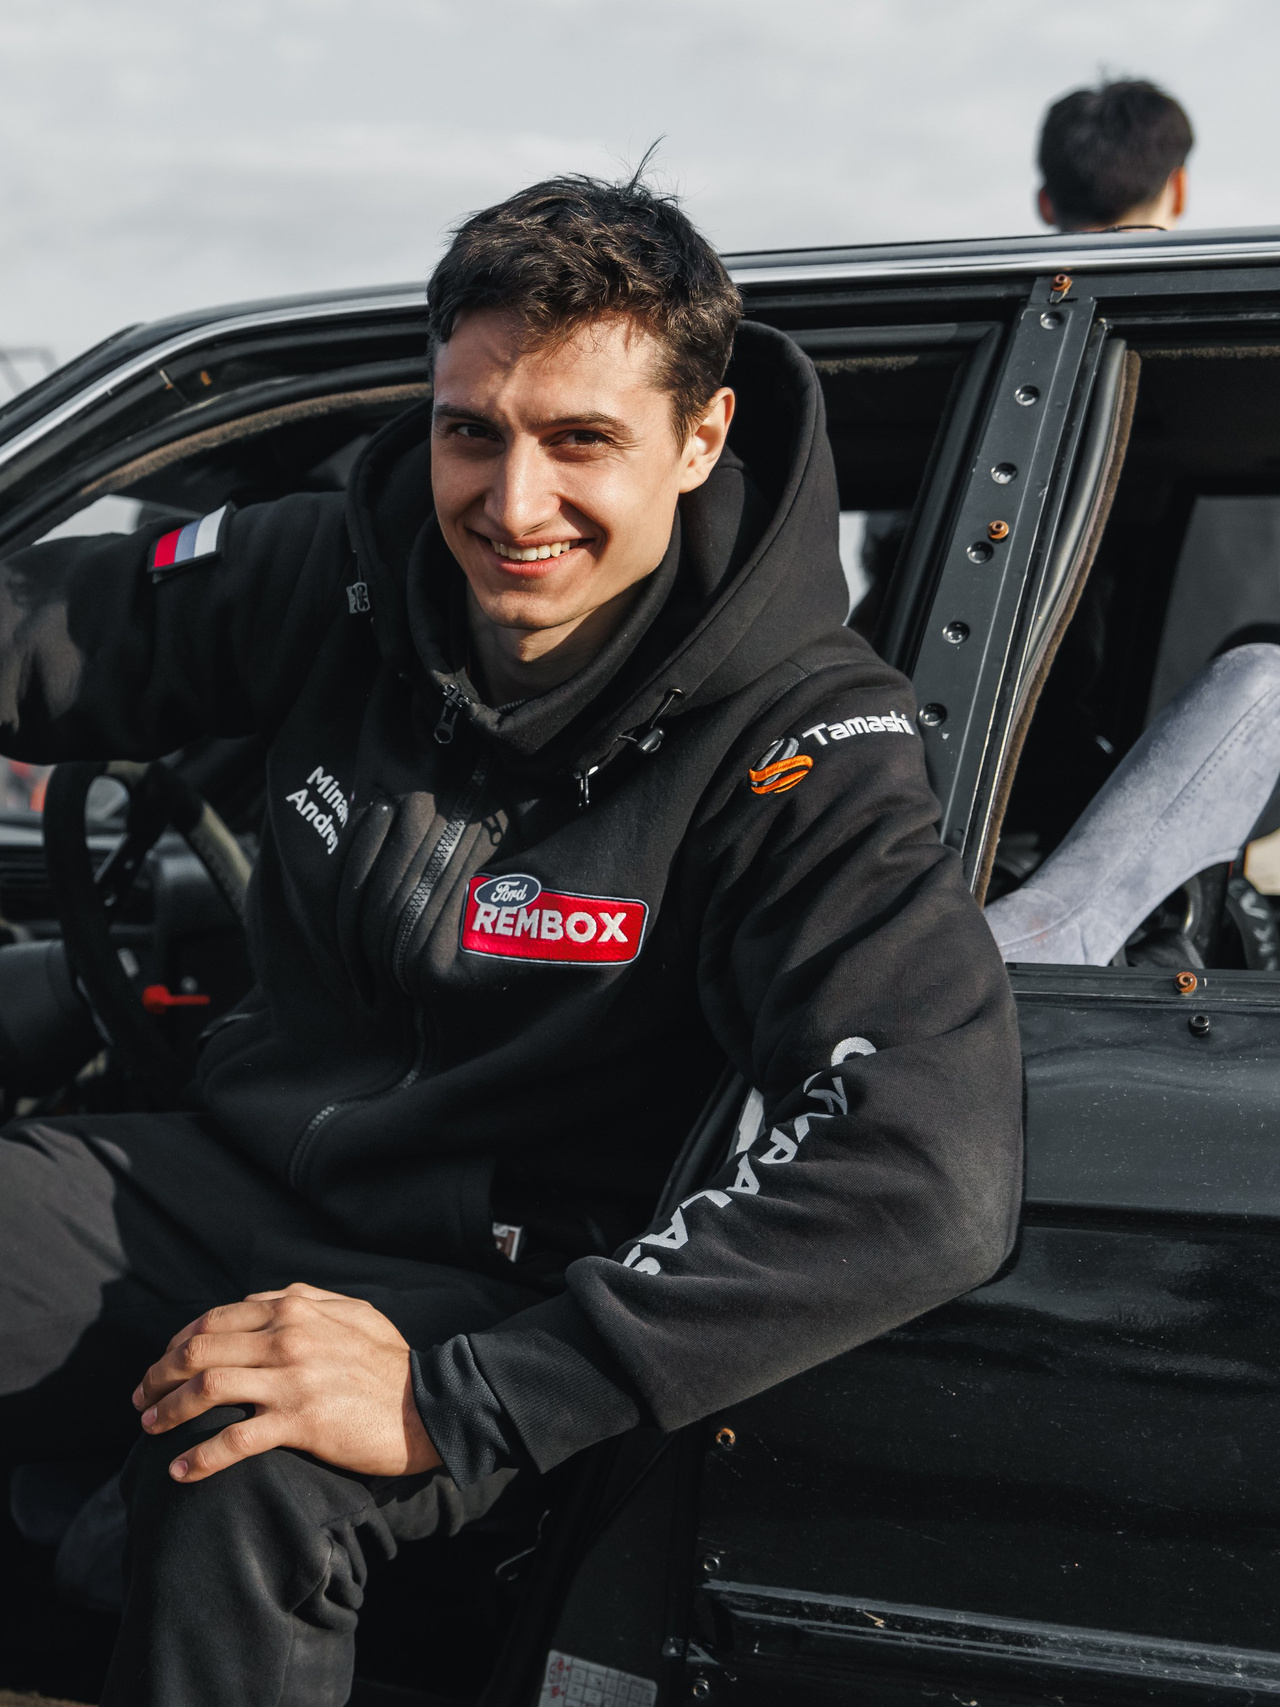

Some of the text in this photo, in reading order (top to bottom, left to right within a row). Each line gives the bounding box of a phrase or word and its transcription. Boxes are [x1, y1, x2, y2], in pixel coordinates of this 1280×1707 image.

[802, 710, 914, 745] Tamashi
[285, 788, 338, 855] Andrey
[490, 880, 528, 903] Ford
[472, 903, 628, 943] REMBOX
